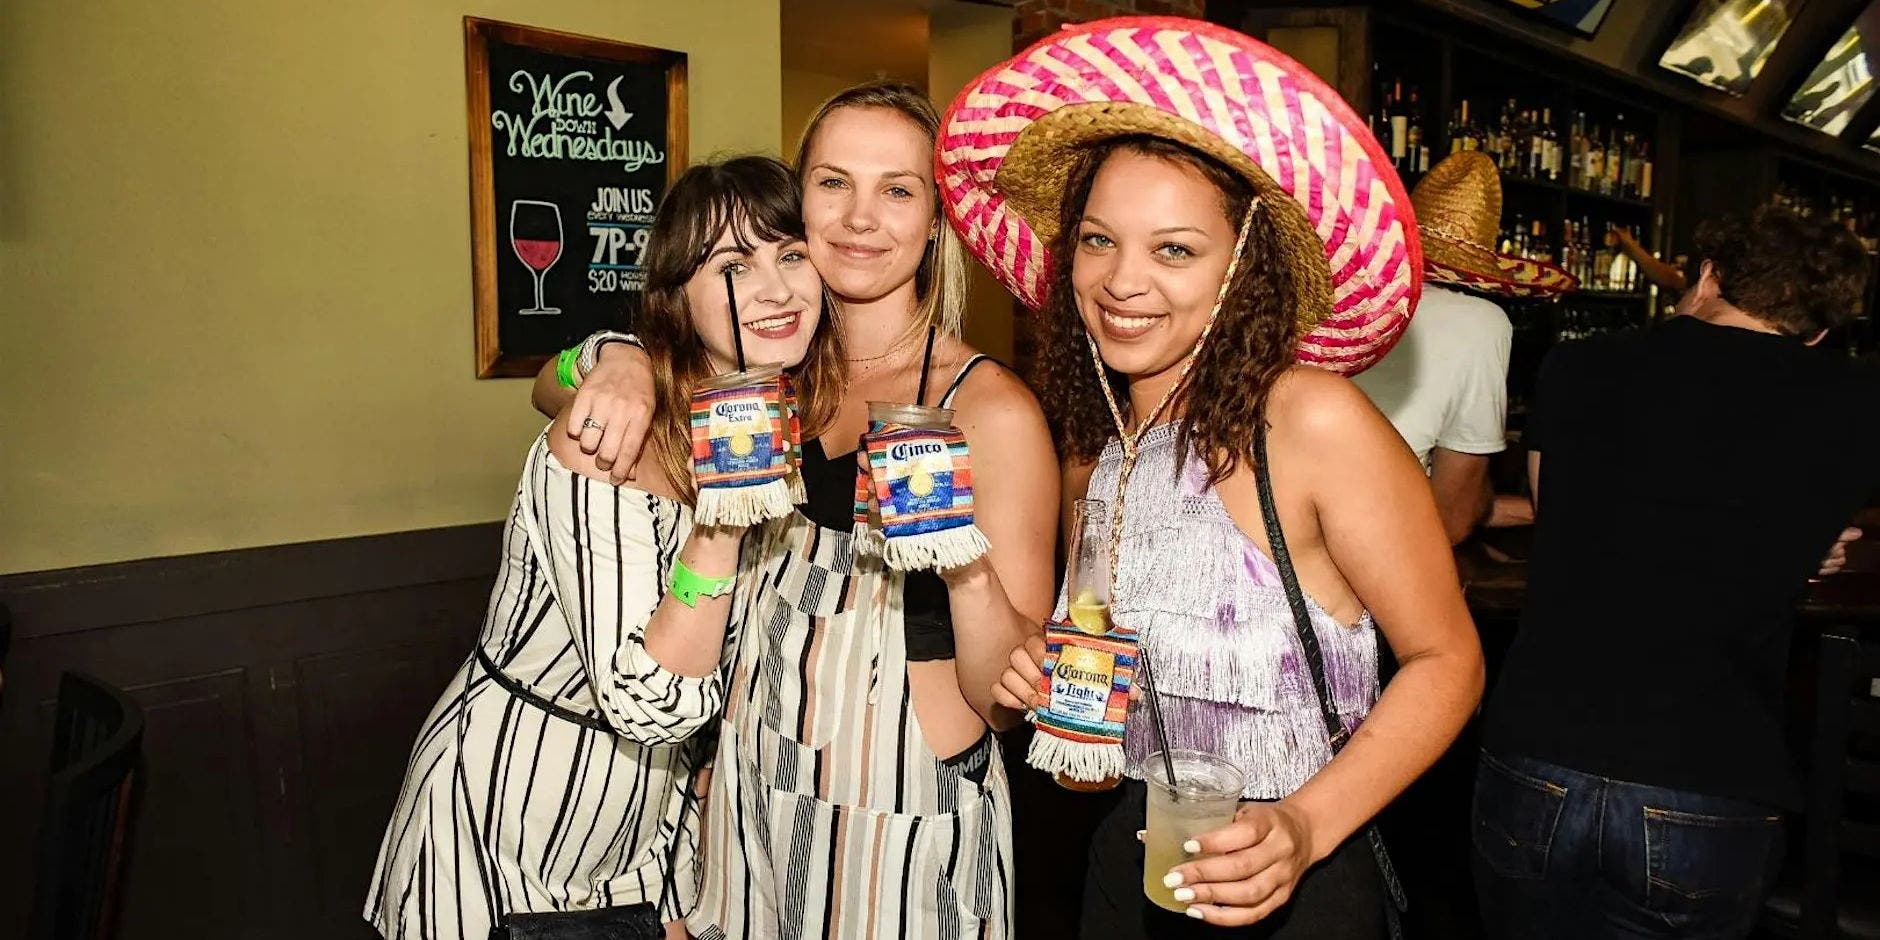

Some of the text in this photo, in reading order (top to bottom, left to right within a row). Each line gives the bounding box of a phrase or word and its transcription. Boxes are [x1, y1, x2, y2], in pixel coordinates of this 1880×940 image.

[509, 70, 603, 118] Wine
[492, 109, 664, 172] Wednesdays
[591, 187, 653, 213] JOIN US
[588, 269, 617, 293] $20
[715, 402, 760, 417] Corona
[728, 414, 753, 422] Extra
[891, 443, 942, 461] Cinco
[1056, 662, 1108, 687] Corona
[1065, 683, 1095, 700] Light
